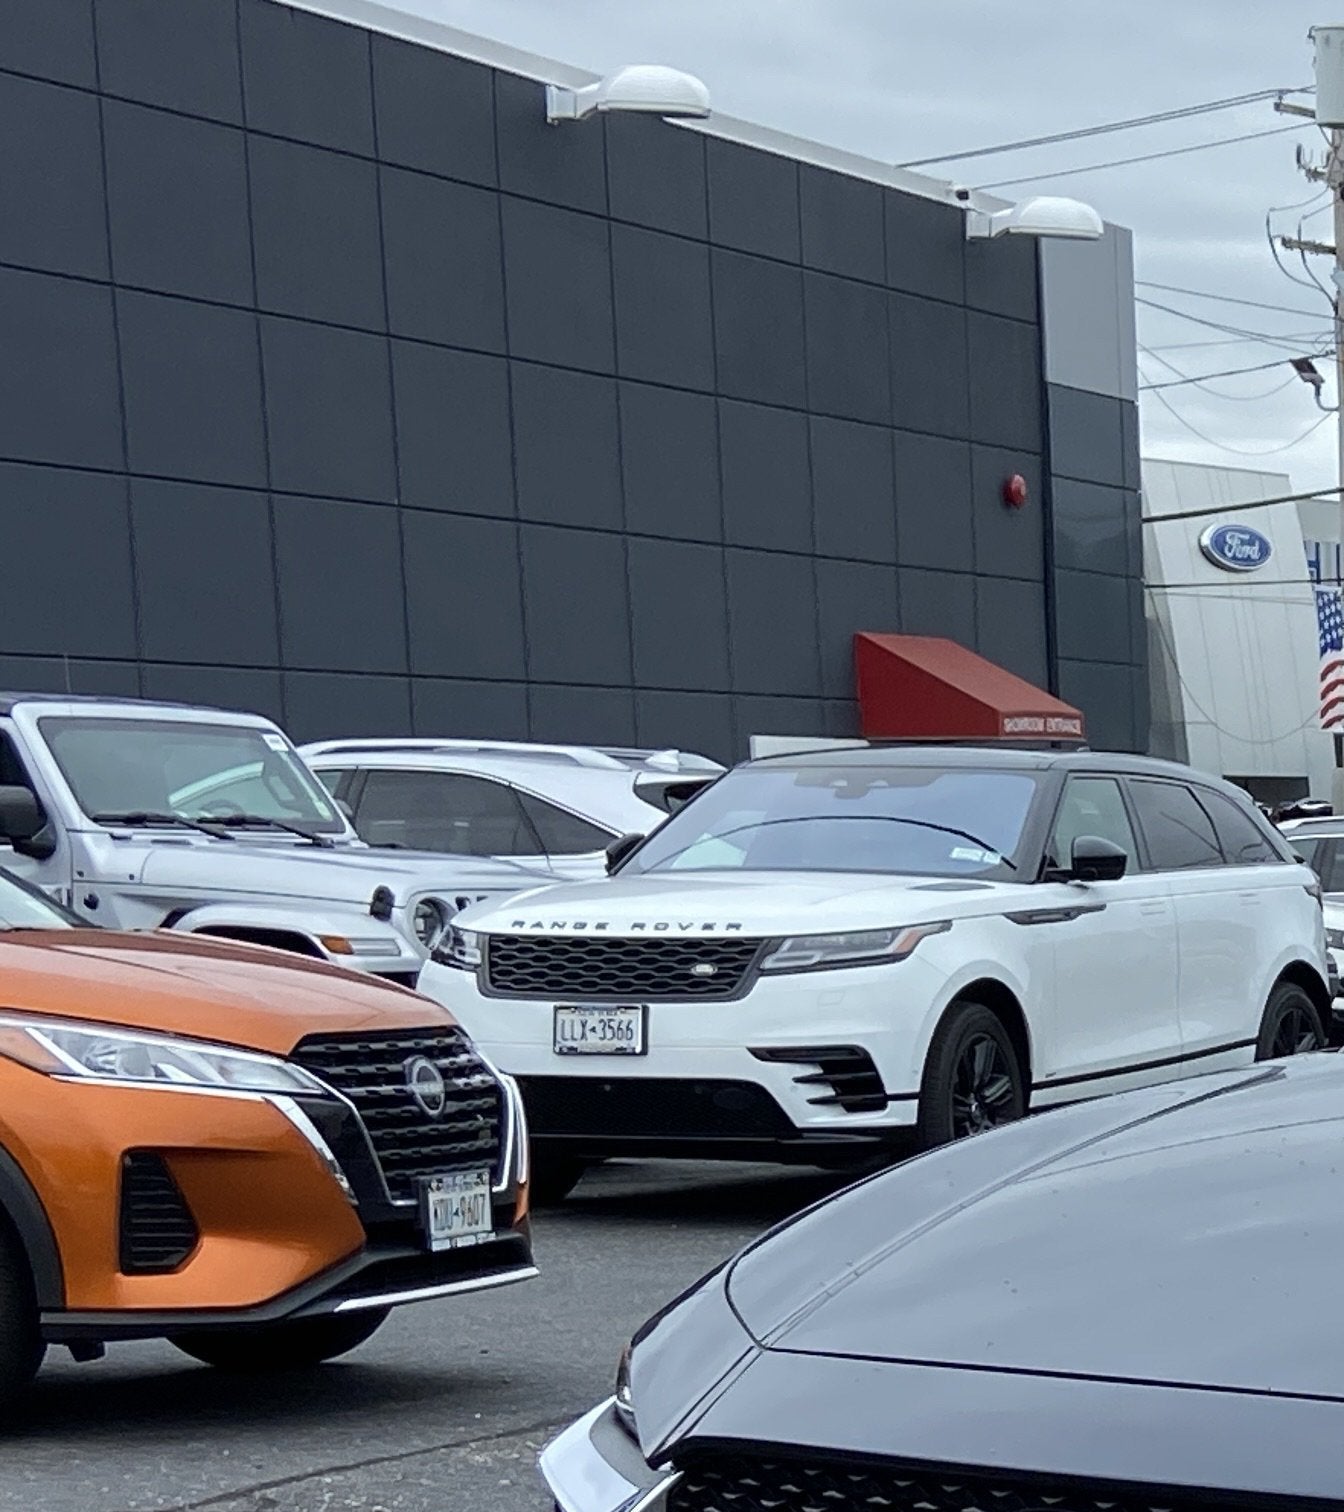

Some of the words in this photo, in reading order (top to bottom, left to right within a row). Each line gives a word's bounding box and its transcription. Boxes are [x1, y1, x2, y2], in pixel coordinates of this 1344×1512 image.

[1224, 531, 1261, 560] Ford
[511, 920, 610, 931] RANGE
[630, 922, 742, 931] ROVER
[561, 1019, 588, 1041] LLX
[598, 1019, 634, 1041] 3566
